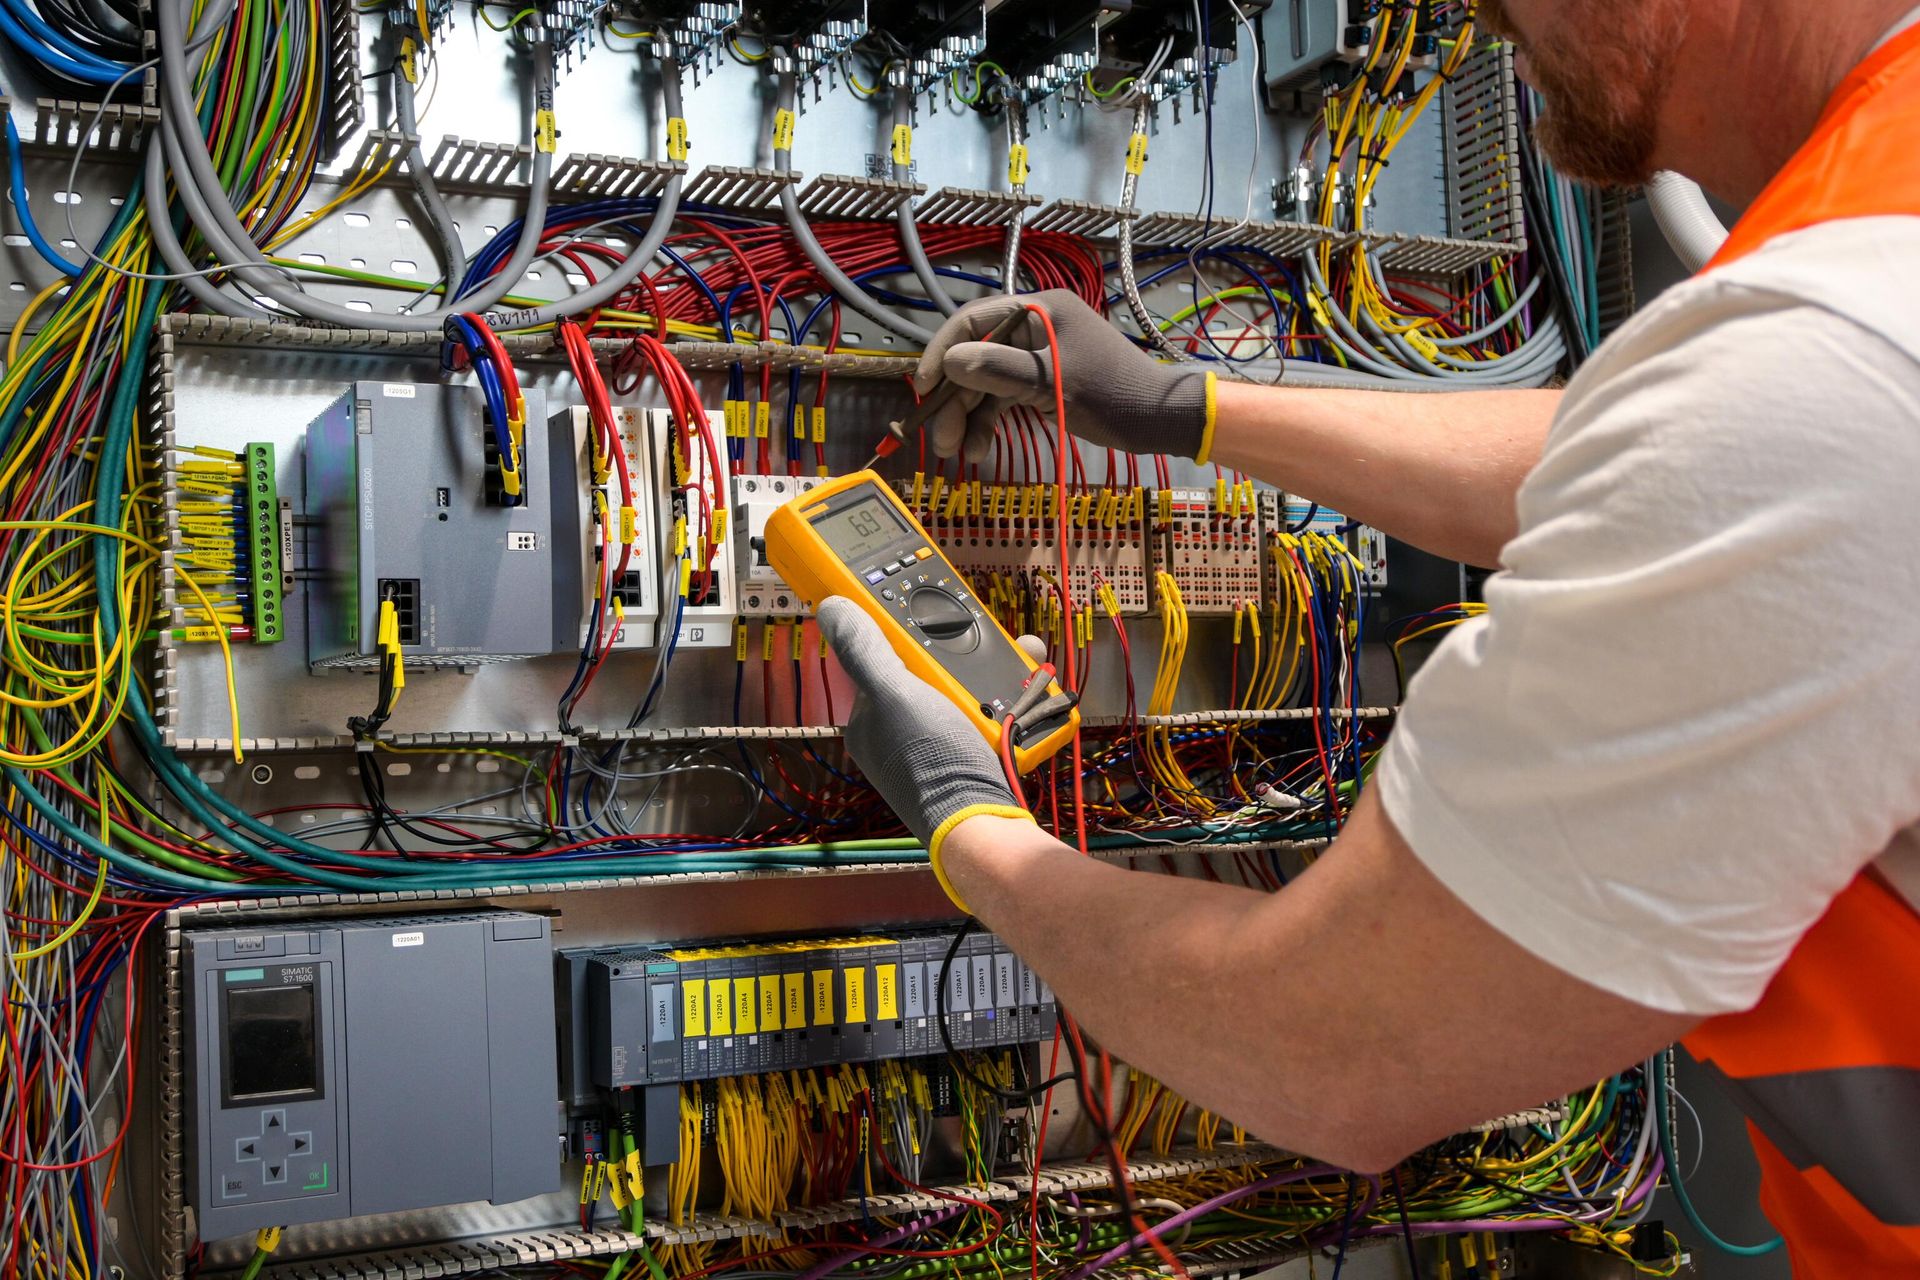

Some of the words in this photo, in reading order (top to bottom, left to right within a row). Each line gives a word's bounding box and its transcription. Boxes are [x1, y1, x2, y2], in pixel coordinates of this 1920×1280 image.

[364, 467, 373, 504] PSU6200
[364, 505, 373, 530] SITOP
[848, 510, 882, 538] 6.9
[284, 522, 292, 559] -120XPE1
[281, 966, 313, 976] SIMATIC
[283, 974, 314, 983] S7-1500
[309, 1171, 320, 1181] OK
[227, 1181, 242, 1190] ESC
